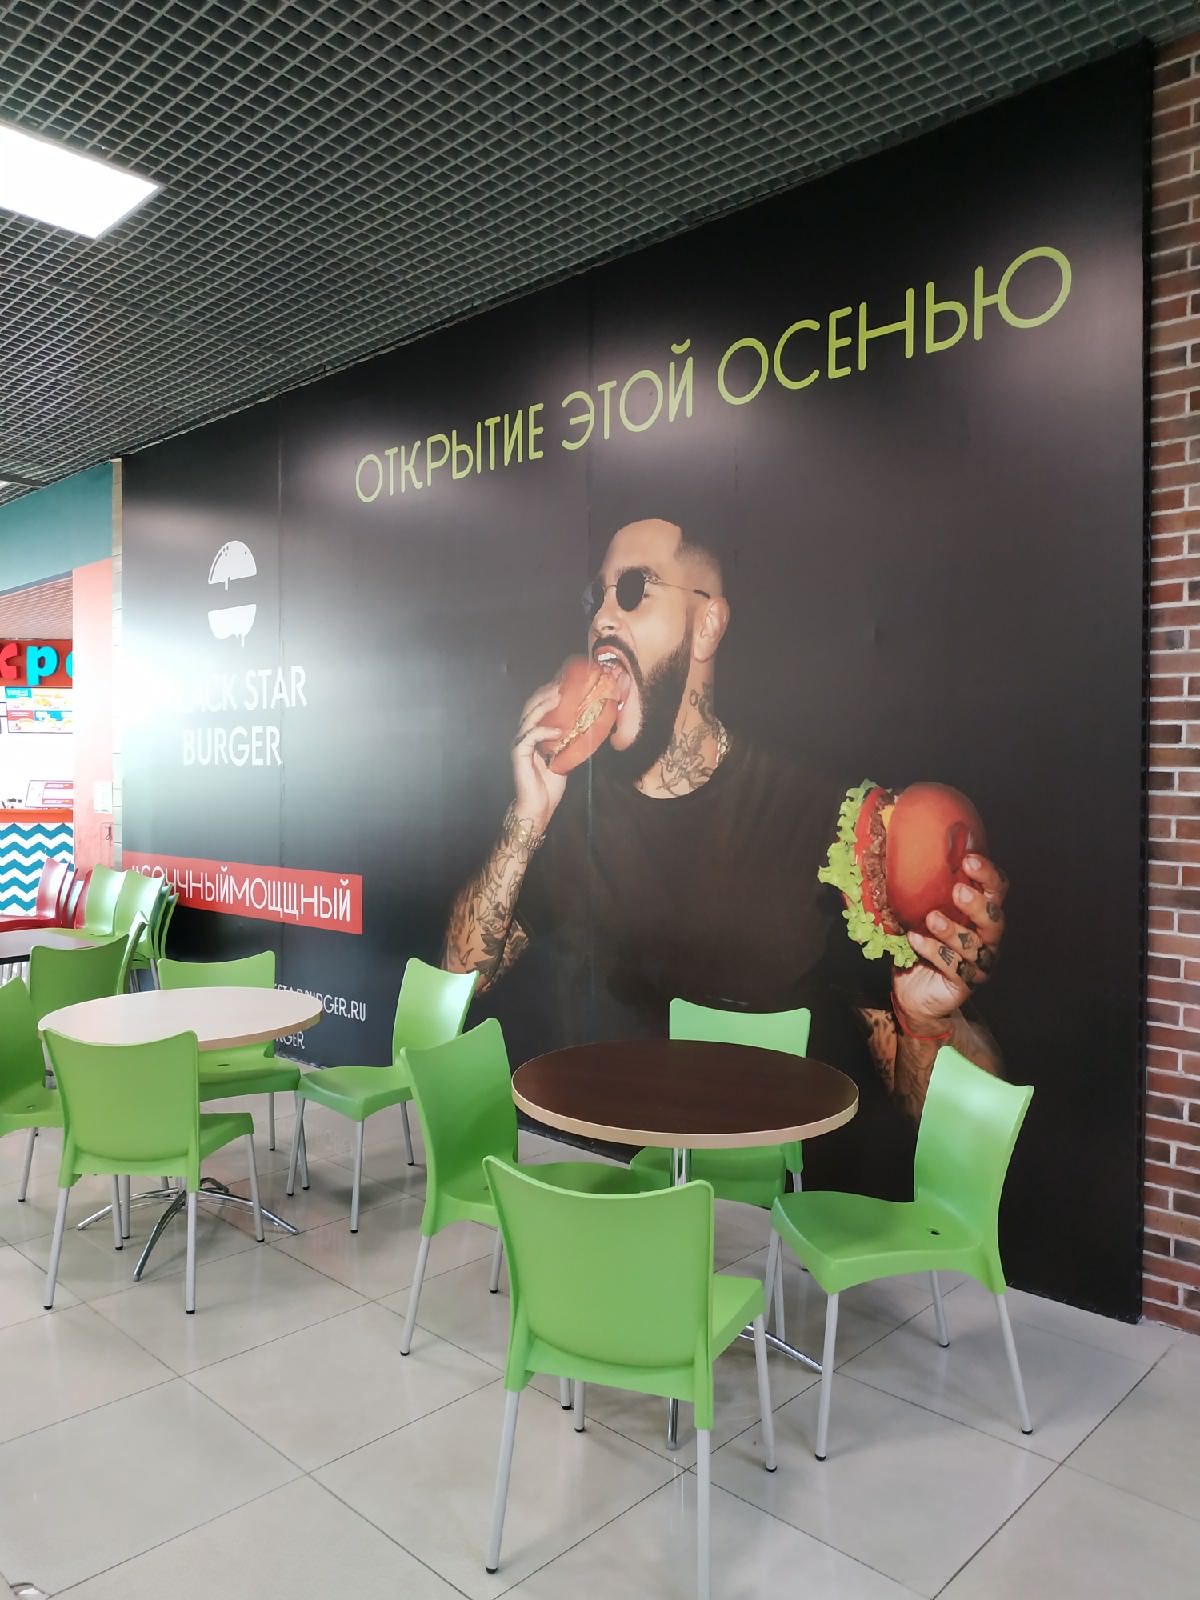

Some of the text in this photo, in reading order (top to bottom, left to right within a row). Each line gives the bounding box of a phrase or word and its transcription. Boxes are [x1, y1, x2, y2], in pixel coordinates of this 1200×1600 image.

[355, 245, 1072, 503] ОТКРЫТИЕ ЭТОЙ ОСЕНЬЮ
[243, 665, 308, 711] STAR
[183, 725, 283, 767] BURGER
